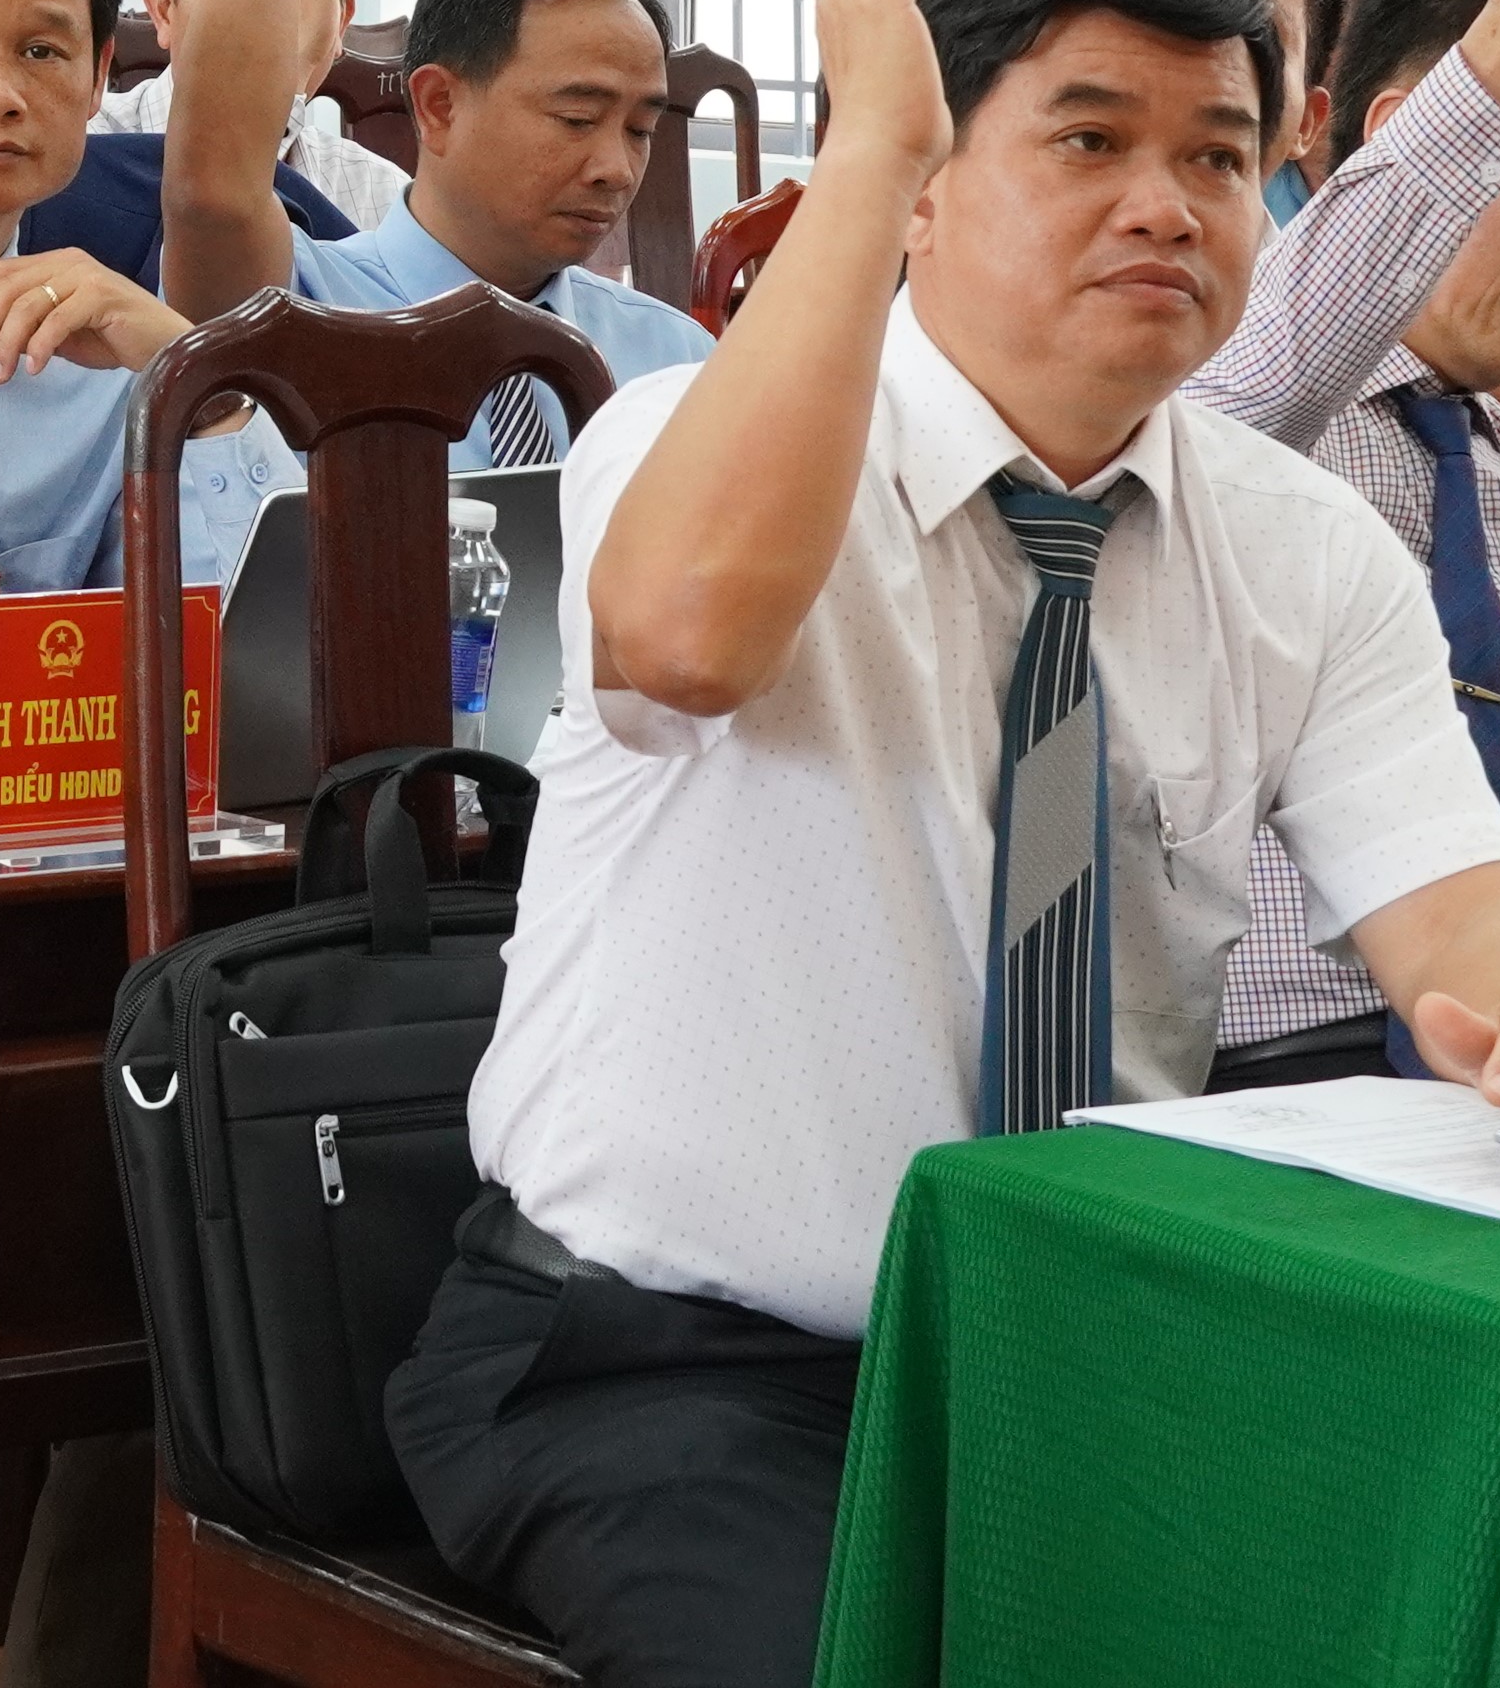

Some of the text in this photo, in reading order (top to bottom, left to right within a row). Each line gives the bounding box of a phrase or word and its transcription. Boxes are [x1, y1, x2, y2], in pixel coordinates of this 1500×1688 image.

[21, 694, 117, 746] THANH
[0, 762, 52, 806] BIỂU
[59, 767, 123, 801] HĐND
